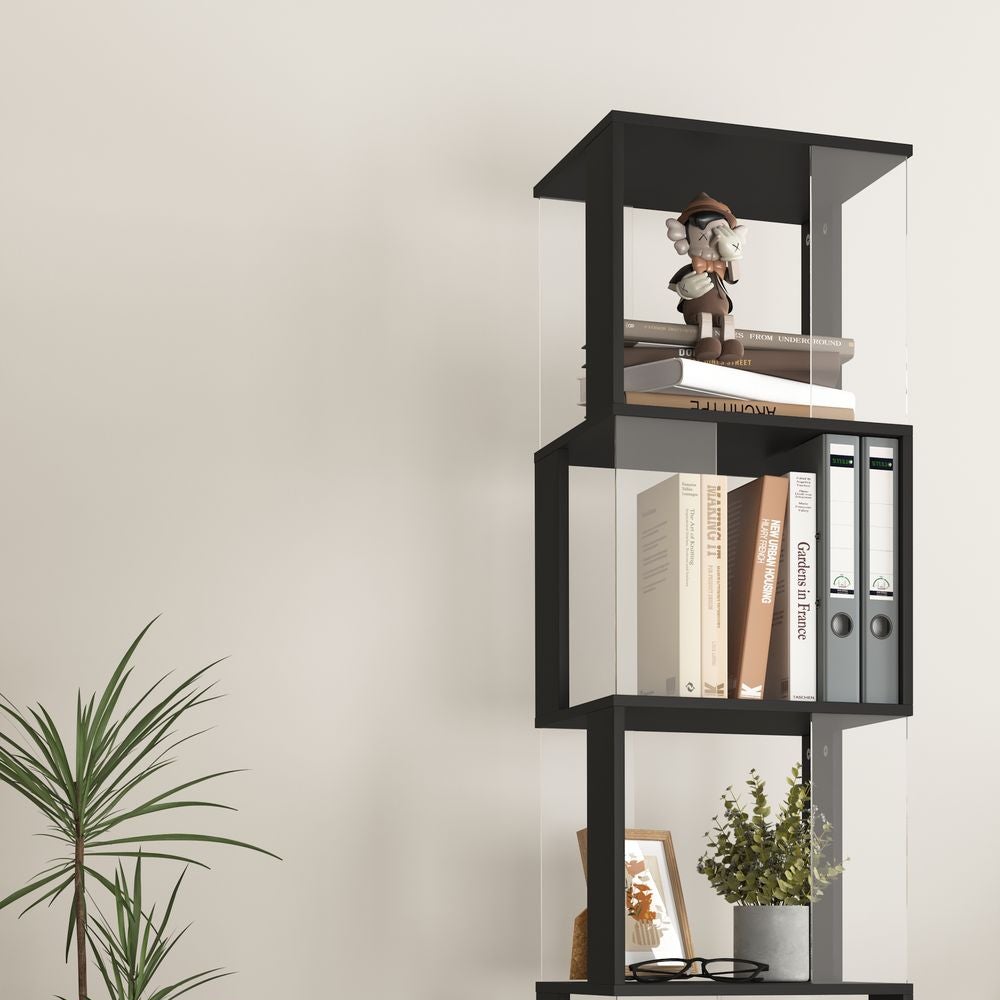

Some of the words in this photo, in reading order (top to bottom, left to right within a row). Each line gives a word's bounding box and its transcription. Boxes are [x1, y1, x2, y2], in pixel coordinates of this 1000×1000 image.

[749, 333, 773, 341] FROM
[778, 335, 842, 347] UNDERGROUND
[706, 484, 721, 541] MAKING
[761, 518, 770, 540] HILARY
[769, 519, 781, 539] NEW
[688, 540, 696, 566] Knitting
[706, 544, 721, 560] IT
[757, 539, 768, 564] FRENCH
[765, 539, 778, 567] URBAN
[797, 541, 811, 587] Gardens
[761, 567, 775, 604] HOUSING
[797, 589, 811, 600] in
[797, 602, 811, 641] France
